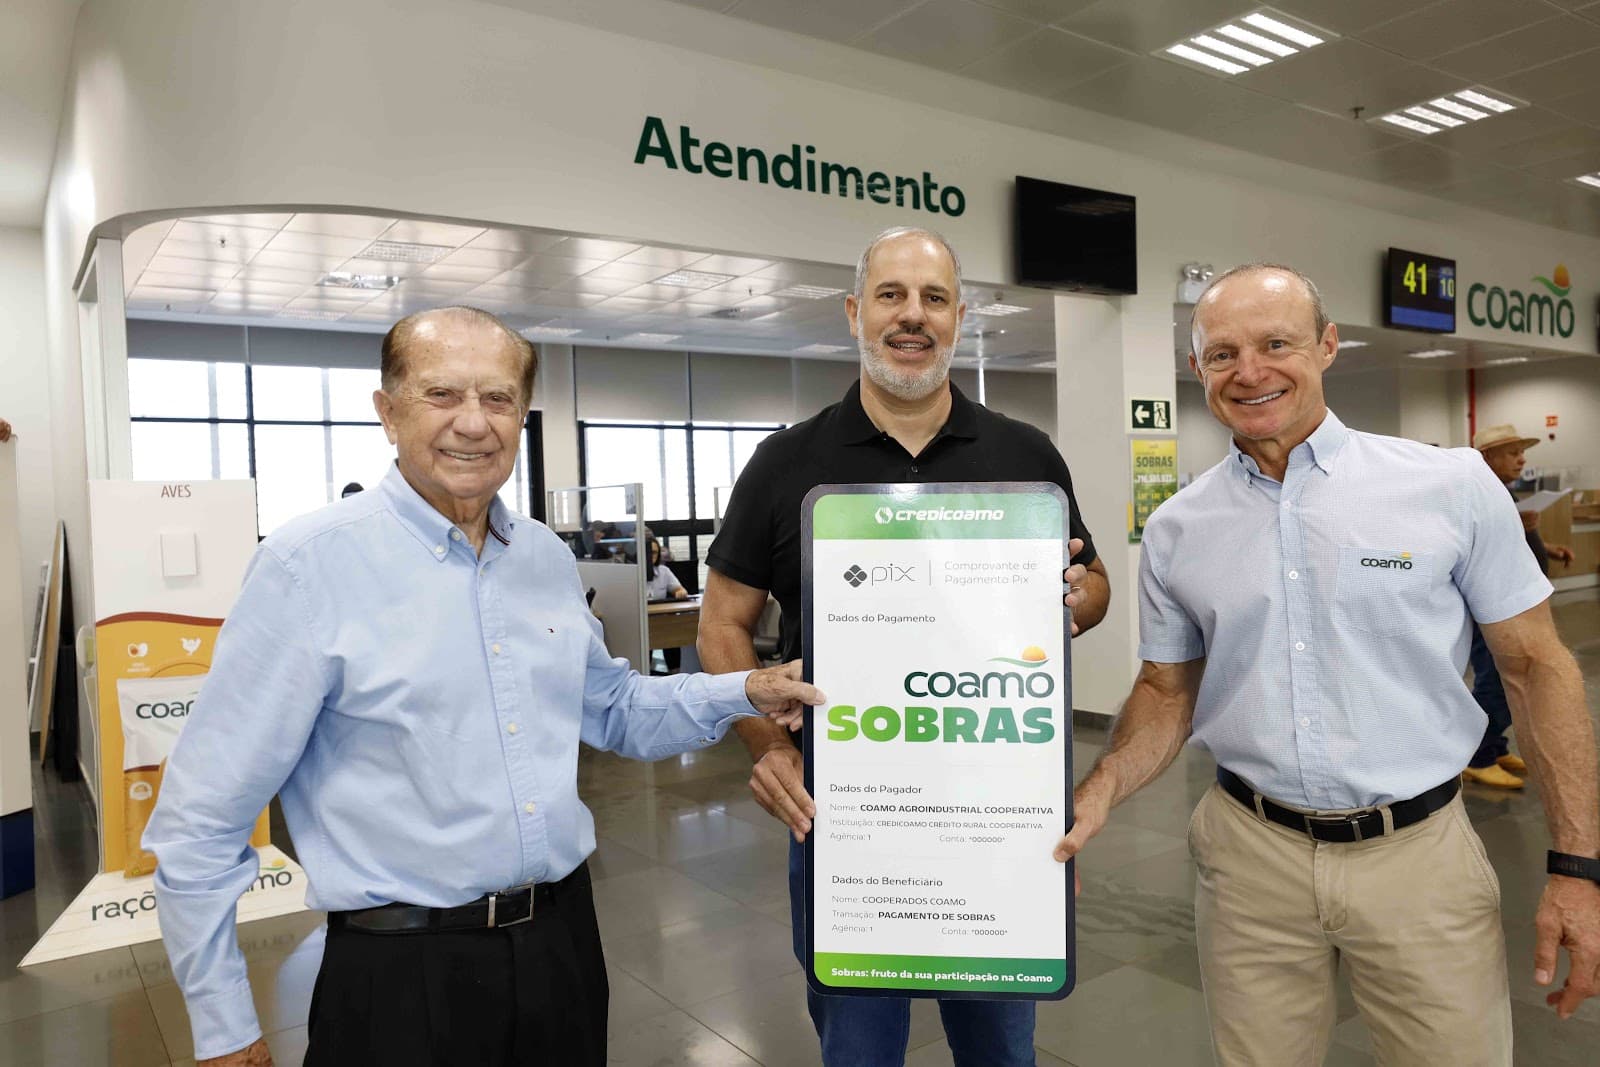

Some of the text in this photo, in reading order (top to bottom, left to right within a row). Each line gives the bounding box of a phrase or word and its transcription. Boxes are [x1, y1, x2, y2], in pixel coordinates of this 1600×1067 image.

[634, 115, 966, 217] Atendimento
[1403, 261, 1427, 295] 41
[1467, 282, 1576, 339] coamo
[1135, 455, 1173, 467] SOBRAS
[160, 484, 192, 498] AVES
[944, 560, 1038, 572] Comprovante de
[1360, 557, 1413, 570] coamo
[871, 563, 916, 587] pix
[944, 574, 1030, 586] Pagamento Pix
[827, 613, 936, 624] Dados do Pagamento
[904, 671, 1055, 699] coamo
[827, 705, 1056, 744] SOBRAS
[829, 783, 922, 795] Dados do Pagador
[860, 804, 896, 812] COAMO
[898, 805, 982, 814] AGROINDUSTRIAL
[984, 806, 1054, 815] COOPERATIVA
[876, 820, 927, 828] CREDICOAMO
[989, 822, 1043, 830] COOPERATIVA
[831, 875, 863, 885] Dados
[865, 876, 879, 885] do
[862, 896, 928, 905] COOPERADOS
[930, 897, 966, 906] COAMO
[878, 911, 940, 920] PAGAMENTO
[941, 913, 955, 921] DE
[957, 913, 996, 922] SOBRAS
[831, 967, 1053, 983] Sobras: fruto da sua participação na Coamo
